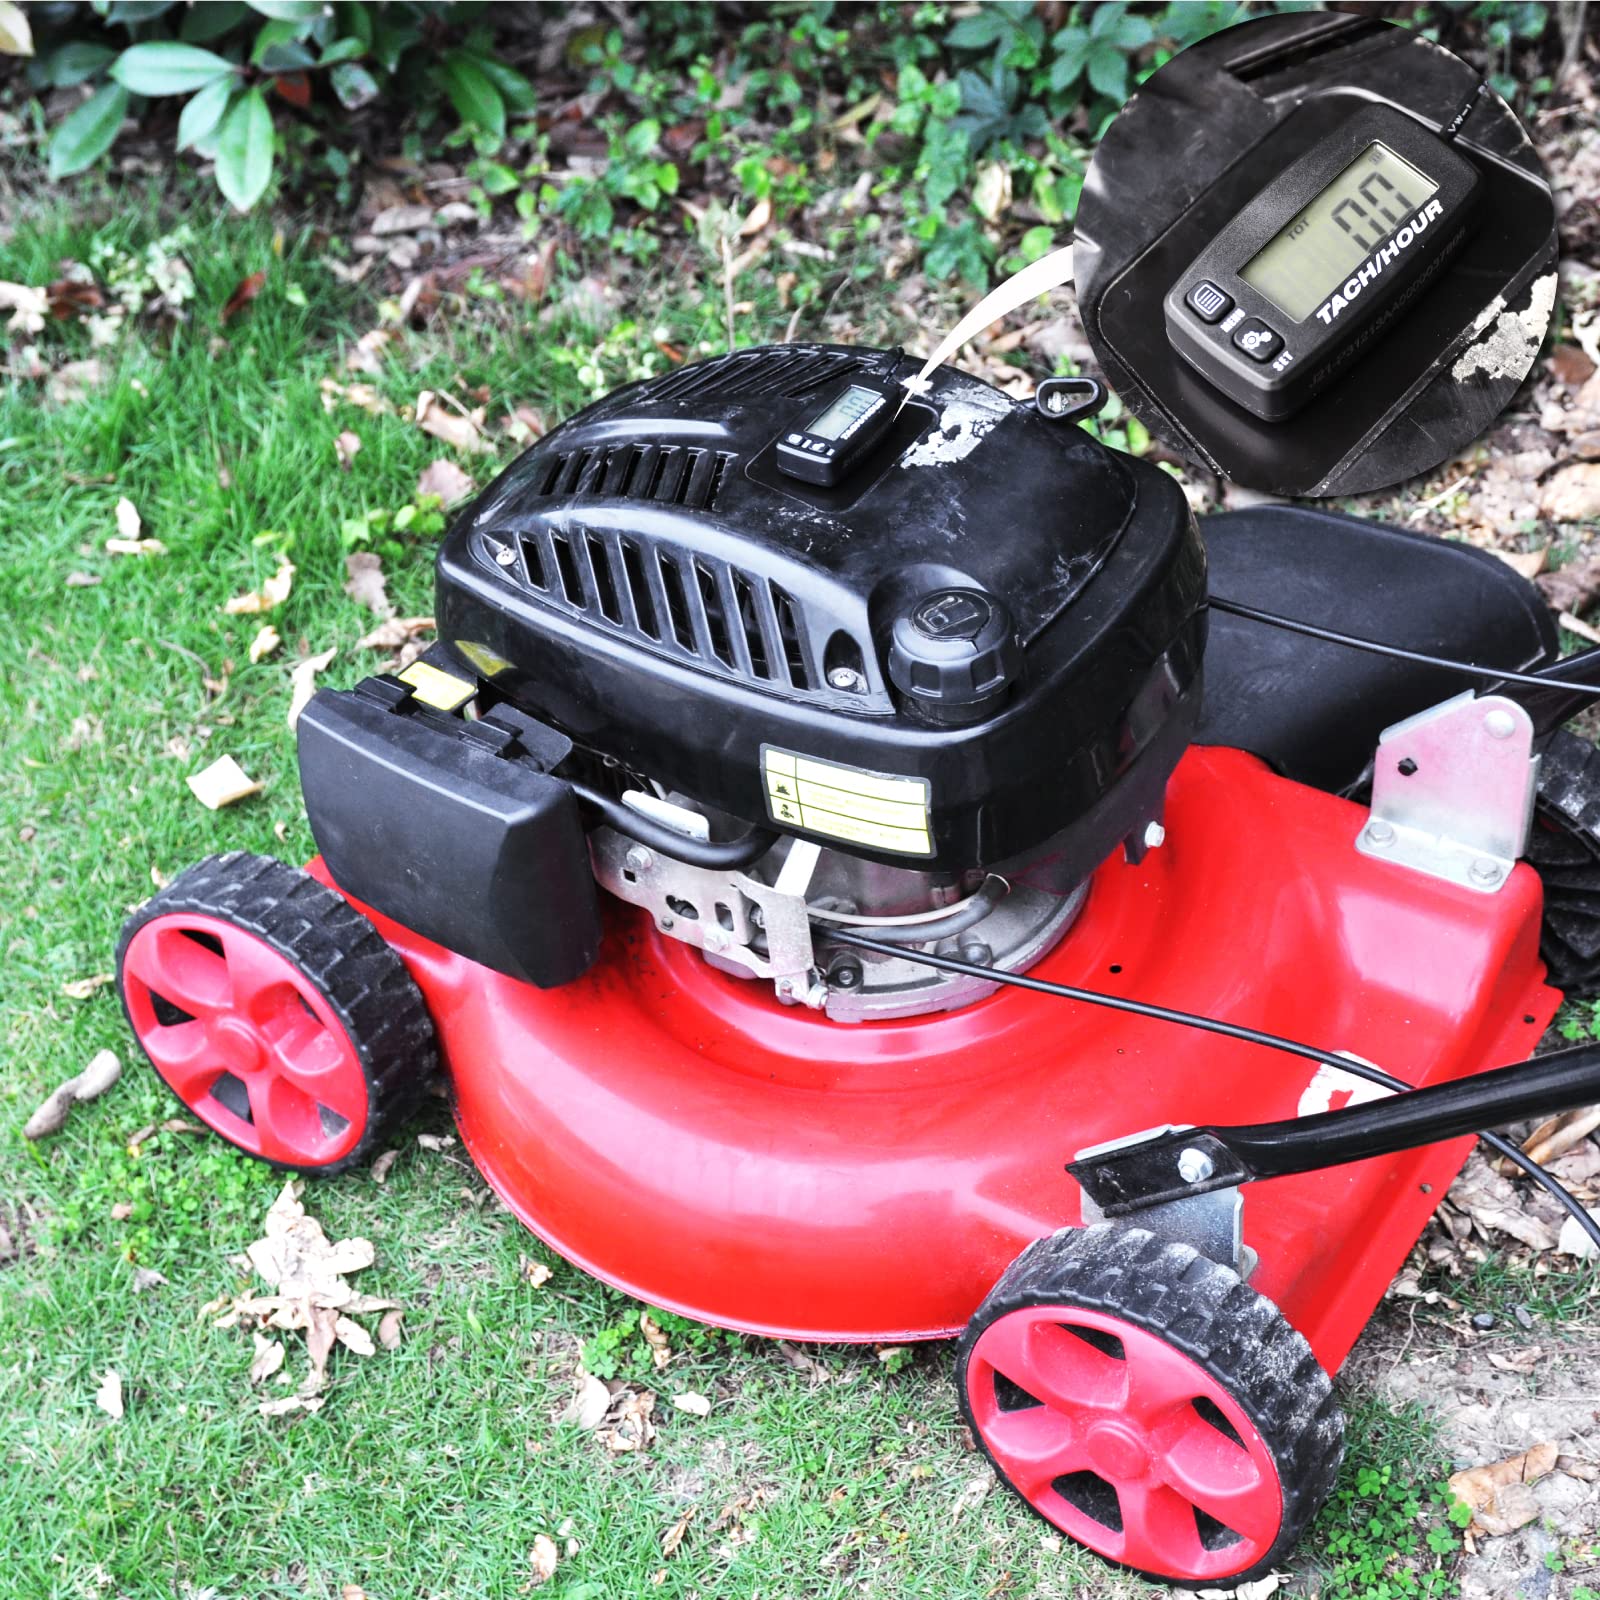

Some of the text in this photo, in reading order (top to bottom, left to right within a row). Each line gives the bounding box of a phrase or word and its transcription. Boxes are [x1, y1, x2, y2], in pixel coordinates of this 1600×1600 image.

[1287, 216, 1311, 241] TOT
[1316, 198, 1444, 325] TACH/HOUR
[1272, 350, 1294, 372] SET
